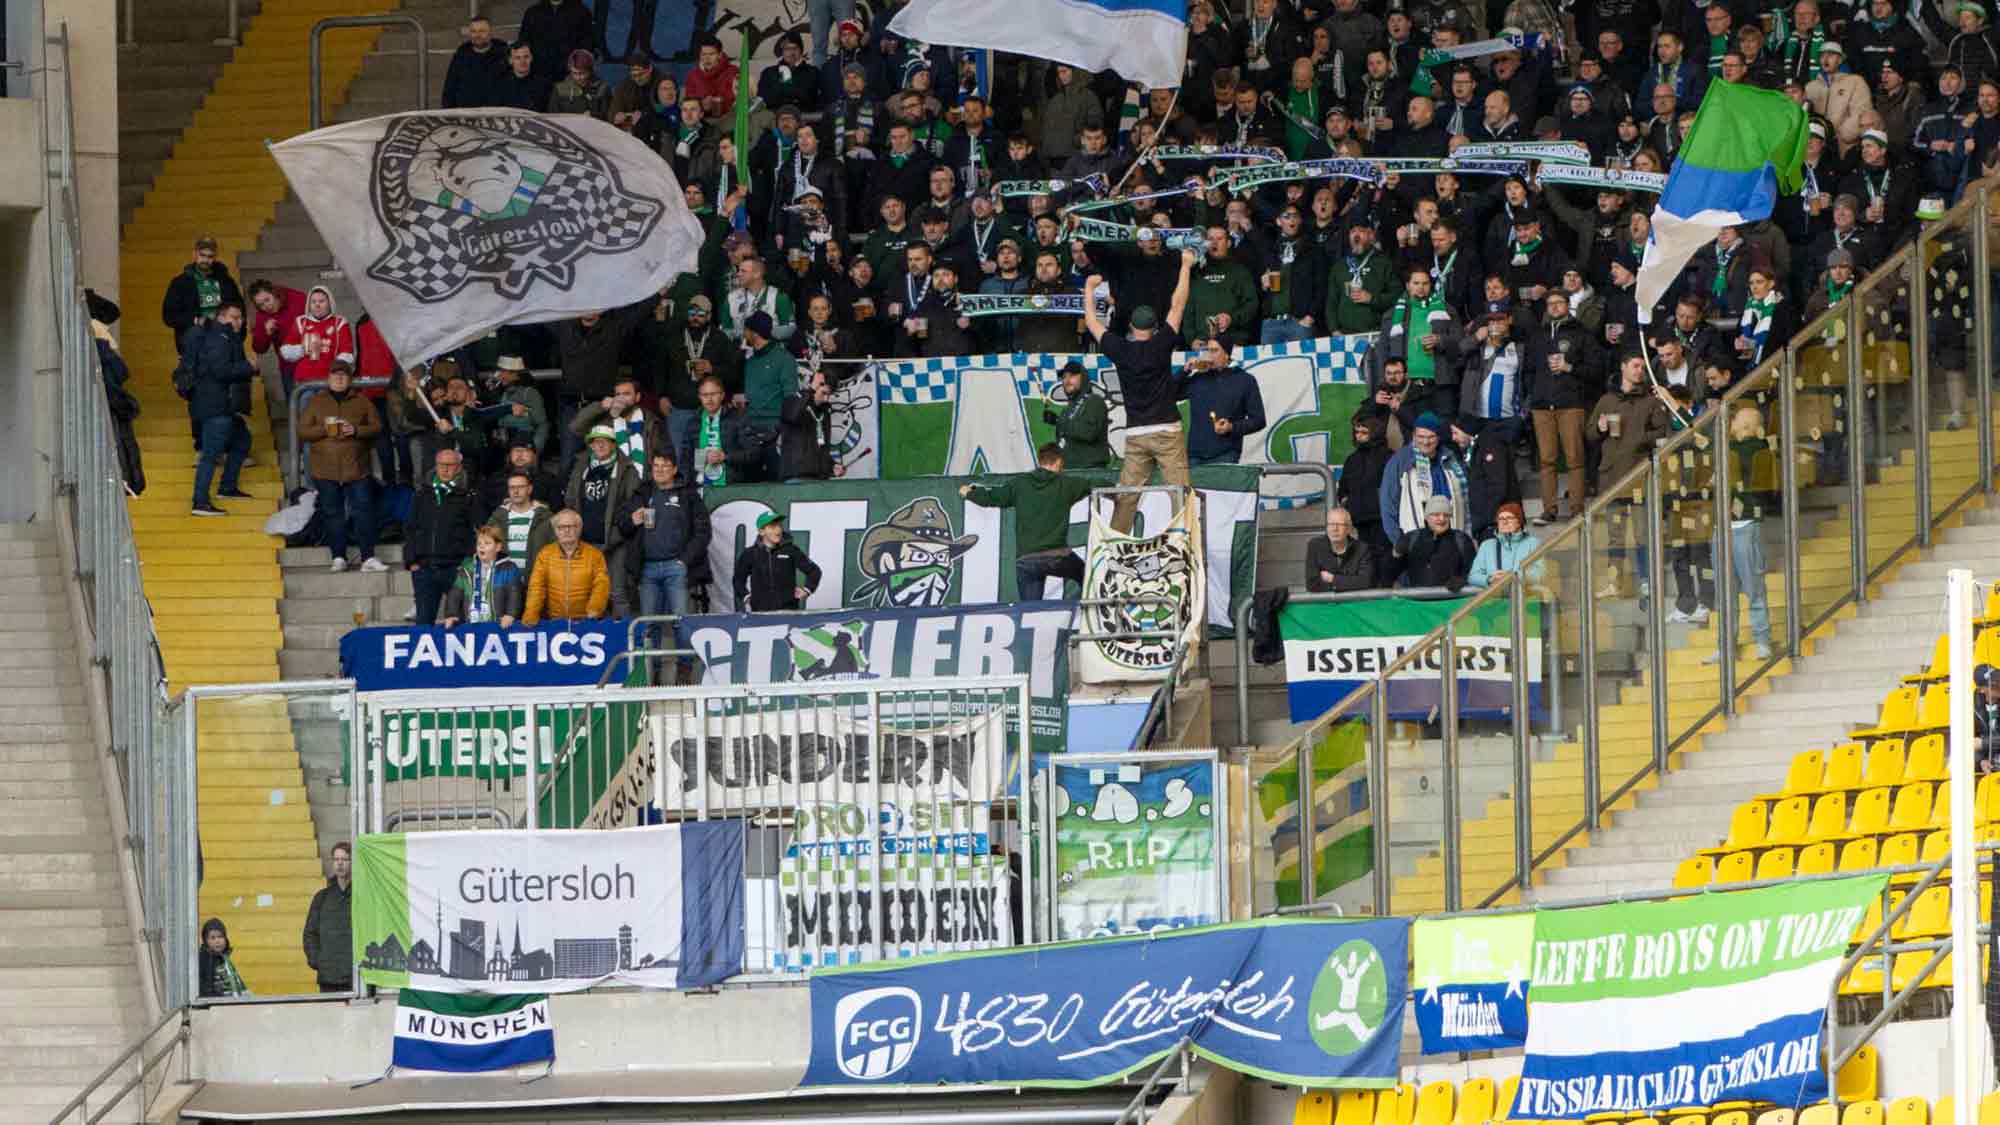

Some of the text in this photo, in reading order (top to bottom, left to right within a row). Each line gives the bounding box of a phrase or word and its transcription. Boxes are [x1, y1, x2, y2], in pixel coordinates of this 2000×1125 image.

[383, 631, 606, 669] FANATICS
[1101, 637, 1174, 667] ÜTERSLO
[368, 718, 588, 768] ÜTERSL
[458, 863, 636, 904] Gütersloh
[1530, 932, 1627, 988] LEFFE
[1629, 923, 1717, 980] BOYS
[1720, 918, 1771, 970] ON
[1773, 905, 1863, 961] TOUR
[849, 1016, 911, 1046] FCG
[934, 991, 1084, 1056] 4830
[1440, 991, 1505, 1038] Münden
